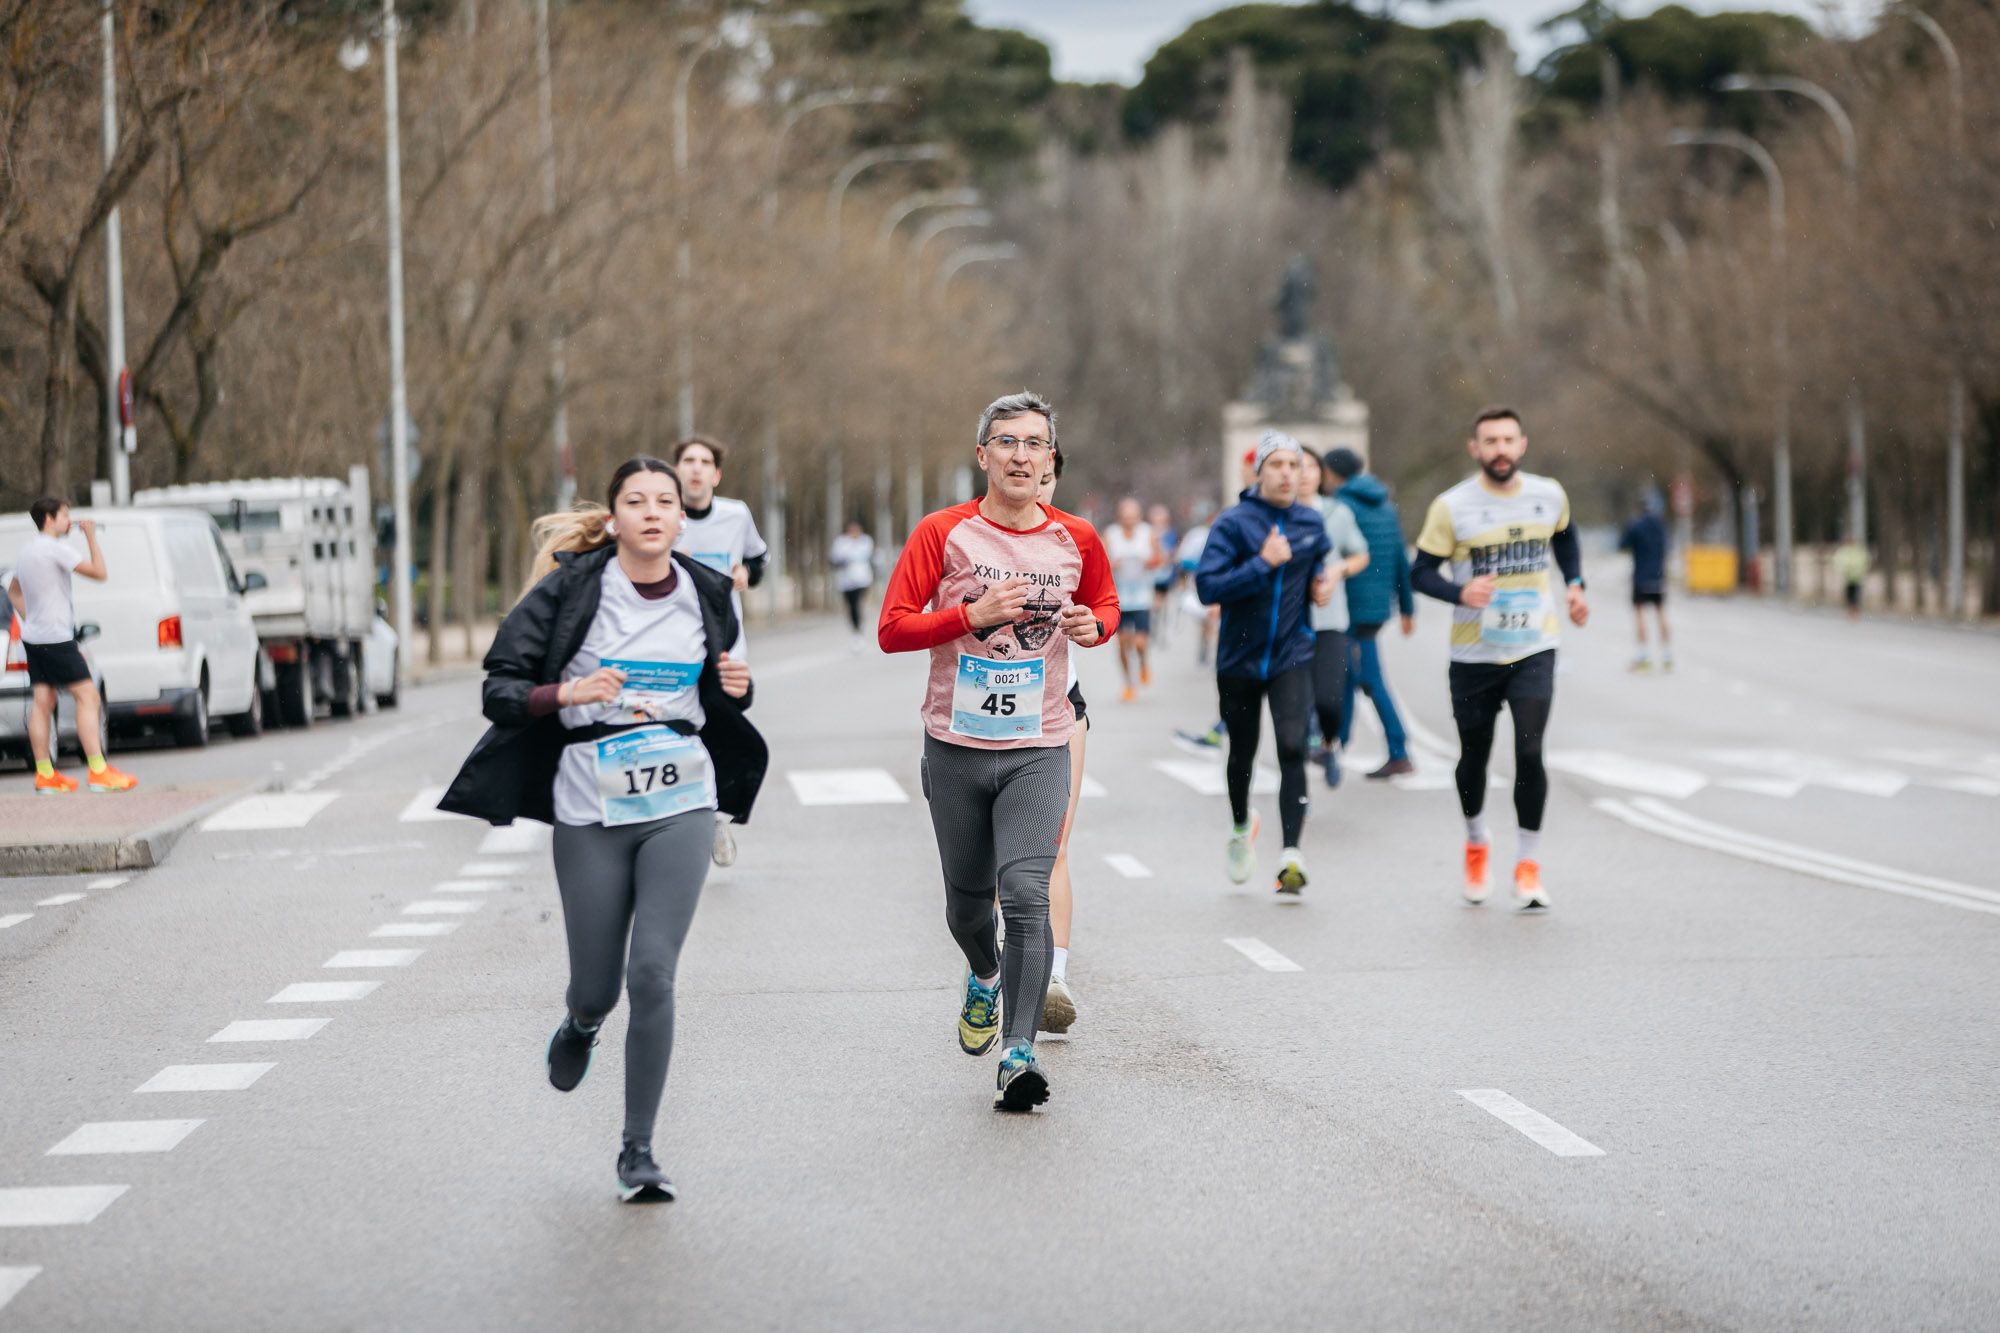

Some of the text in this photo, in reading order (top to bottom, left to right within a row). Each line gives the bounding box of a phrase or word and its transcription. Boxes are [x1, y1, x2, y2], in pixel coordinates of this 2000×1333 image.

[973, 563, 1000, 580] XXII
[1015, 571, 1061, 588] GUAS
[994, 673, 1020, 684] 0021
[980, 693, 1016, 716] 45
[625, 763, 679, 795] 178
